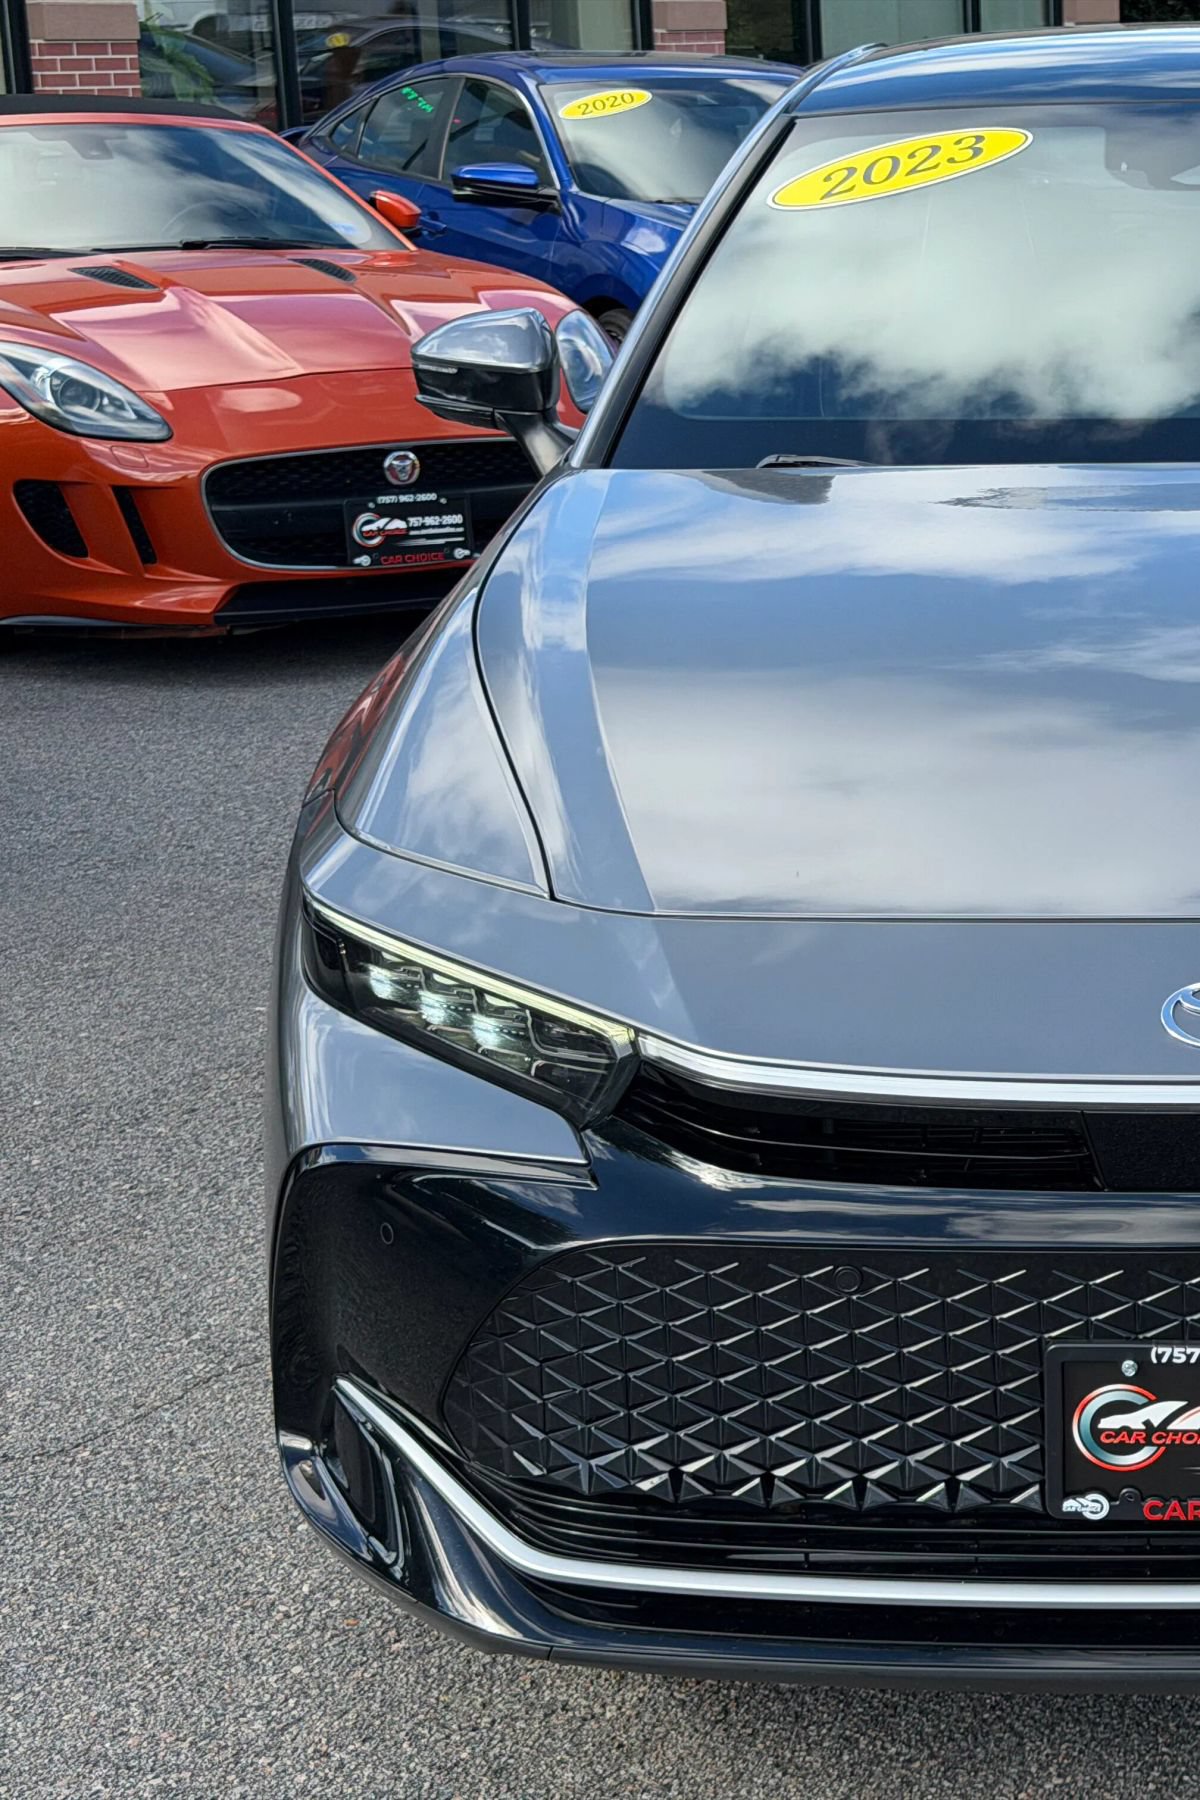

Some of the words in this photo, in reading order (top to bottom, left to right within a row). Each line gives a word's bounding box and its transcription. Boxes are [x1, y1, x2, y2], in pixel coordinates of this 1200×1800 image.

[577, 92, 635, 115] 2020
[819, 134, 986, 201] 2023
[407, 514, 463, 527] 757-962-2600
[381, 555, 403, 565] CAR
[405, 552, 446, 563] CHOICE
[1099, 1430, 1149, 1445] CAR
